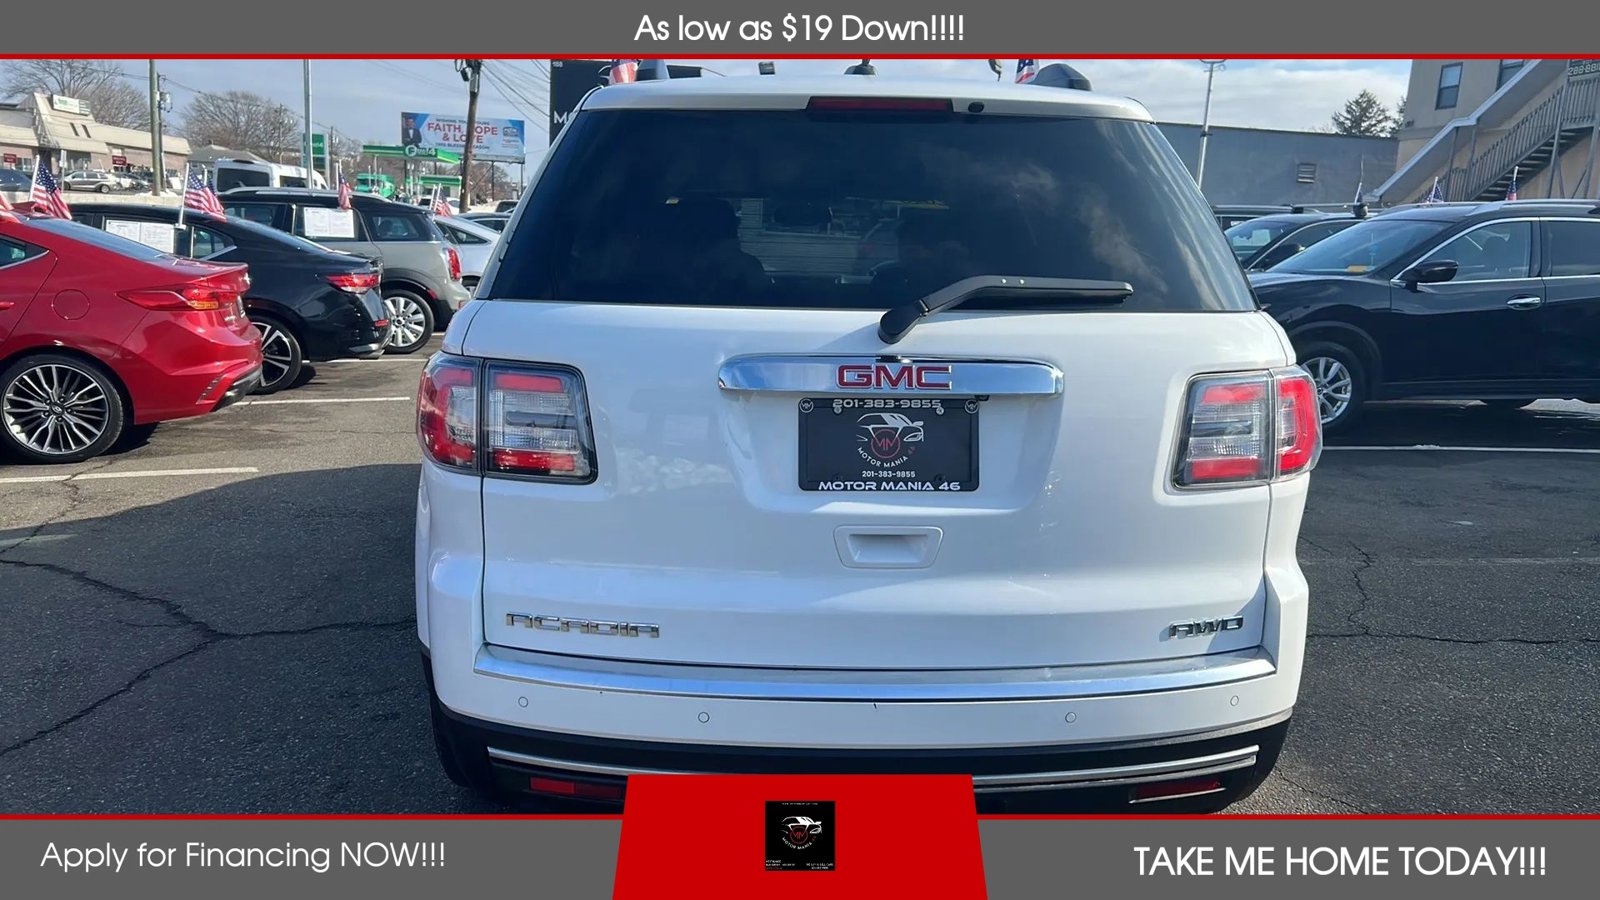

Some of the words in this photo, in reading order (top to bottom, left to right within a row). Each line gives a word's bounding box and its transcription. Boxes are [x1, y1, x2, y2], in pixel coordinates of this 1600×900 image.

[428, 123, 463, 133] FAITH,
[474, 126, 498, 136] OPE
[442, 132, 450, 142] &
[453, 134, 483, 143] LOE
[837, 364, 952, 391] GMC
[832, 399, 942, 409] 201-383-9855
[857, 446, 882, 468] MOTOR
[883, 455, 909, 468] MANIA
[861, 470, 916, 478] 201-383-9855
[818, 481, 877, 491] MOTOR
[880, 481, 935, 491] MANIA
[937, 481, 961, 491] 46
[506, 611, 660, 639] ACADIA
[1168, 615, 1244, 637] AWD
